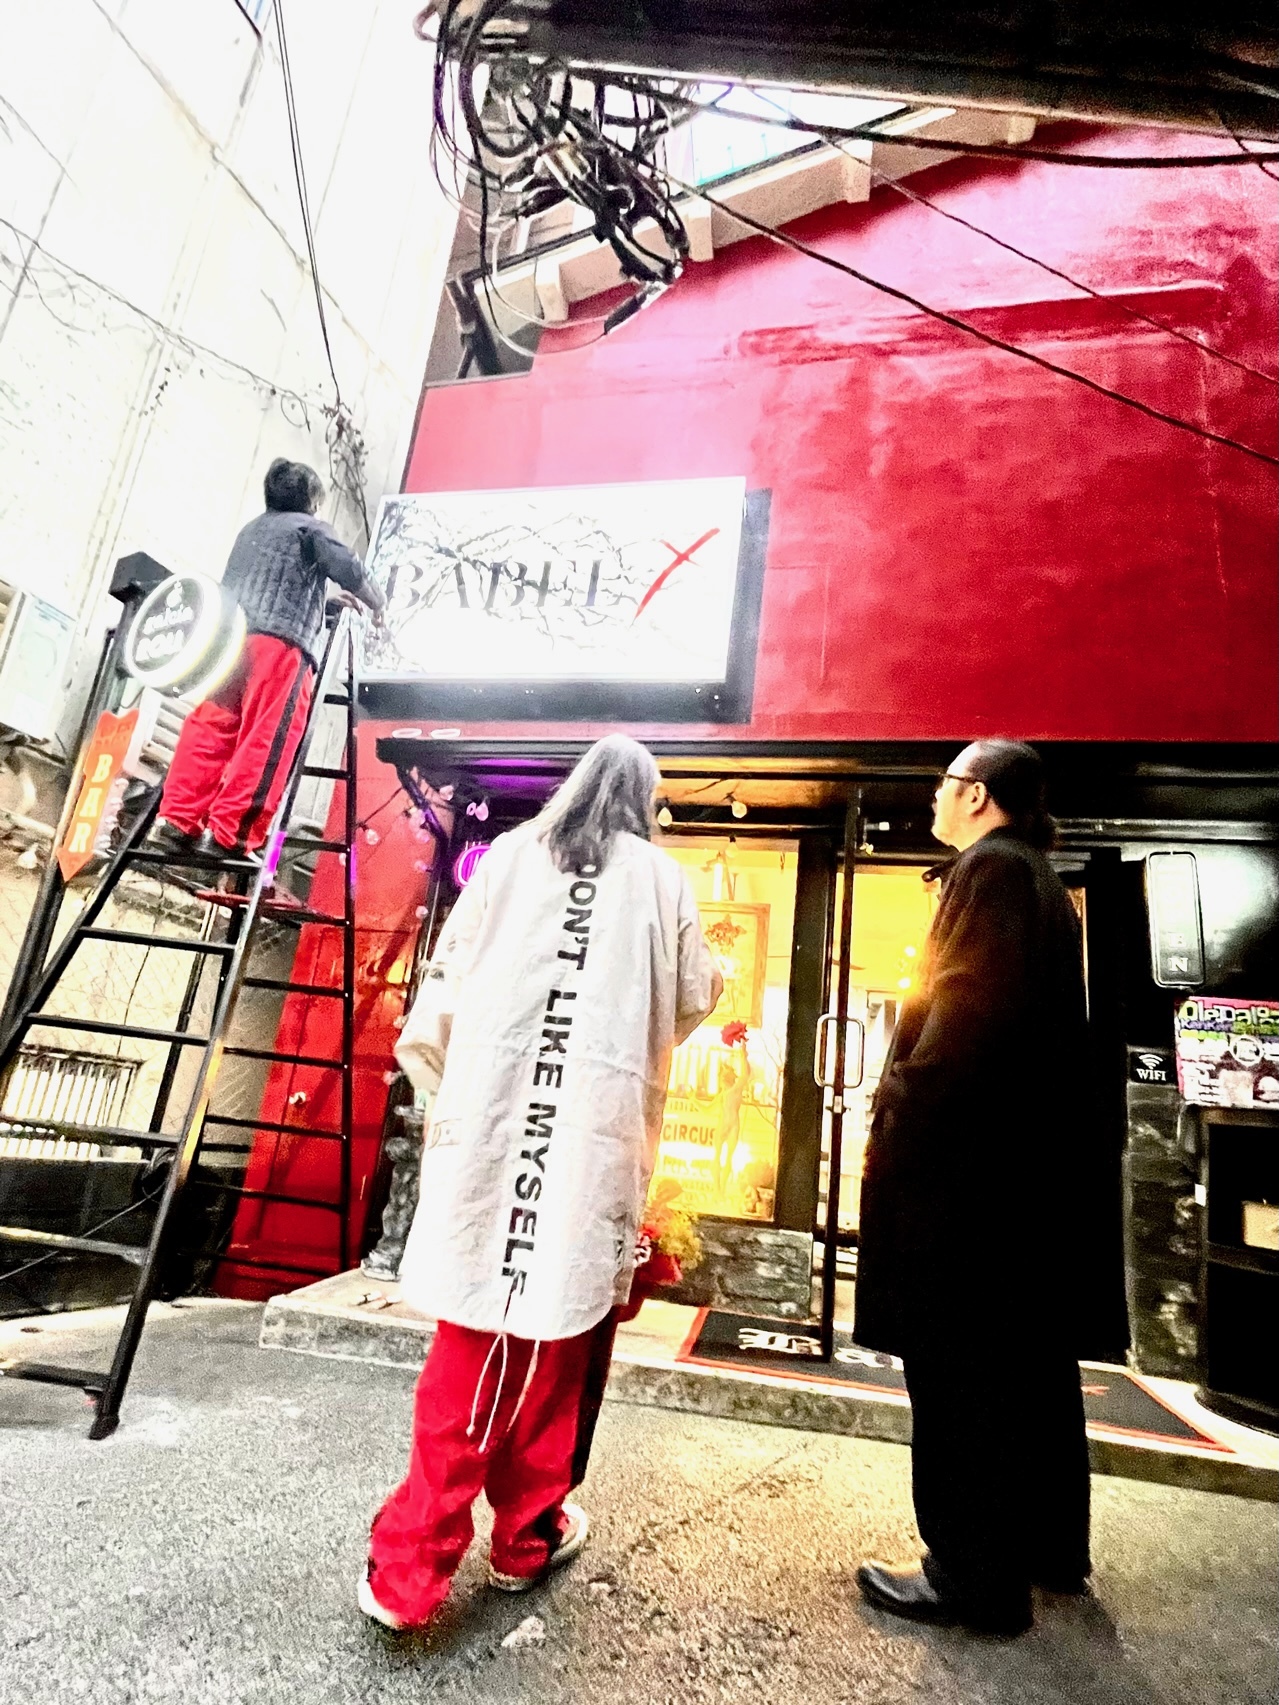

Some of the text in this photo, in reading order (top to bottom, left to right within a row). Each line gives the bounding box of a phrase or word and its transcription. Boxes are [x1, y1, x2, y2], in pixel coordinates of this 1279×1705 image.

[68, 753, 114, 853] BAR
[502, 862, 598, 1296] DON'T LIKE MYSELF
[1136, 1068, 1167, 1082] WIFI
